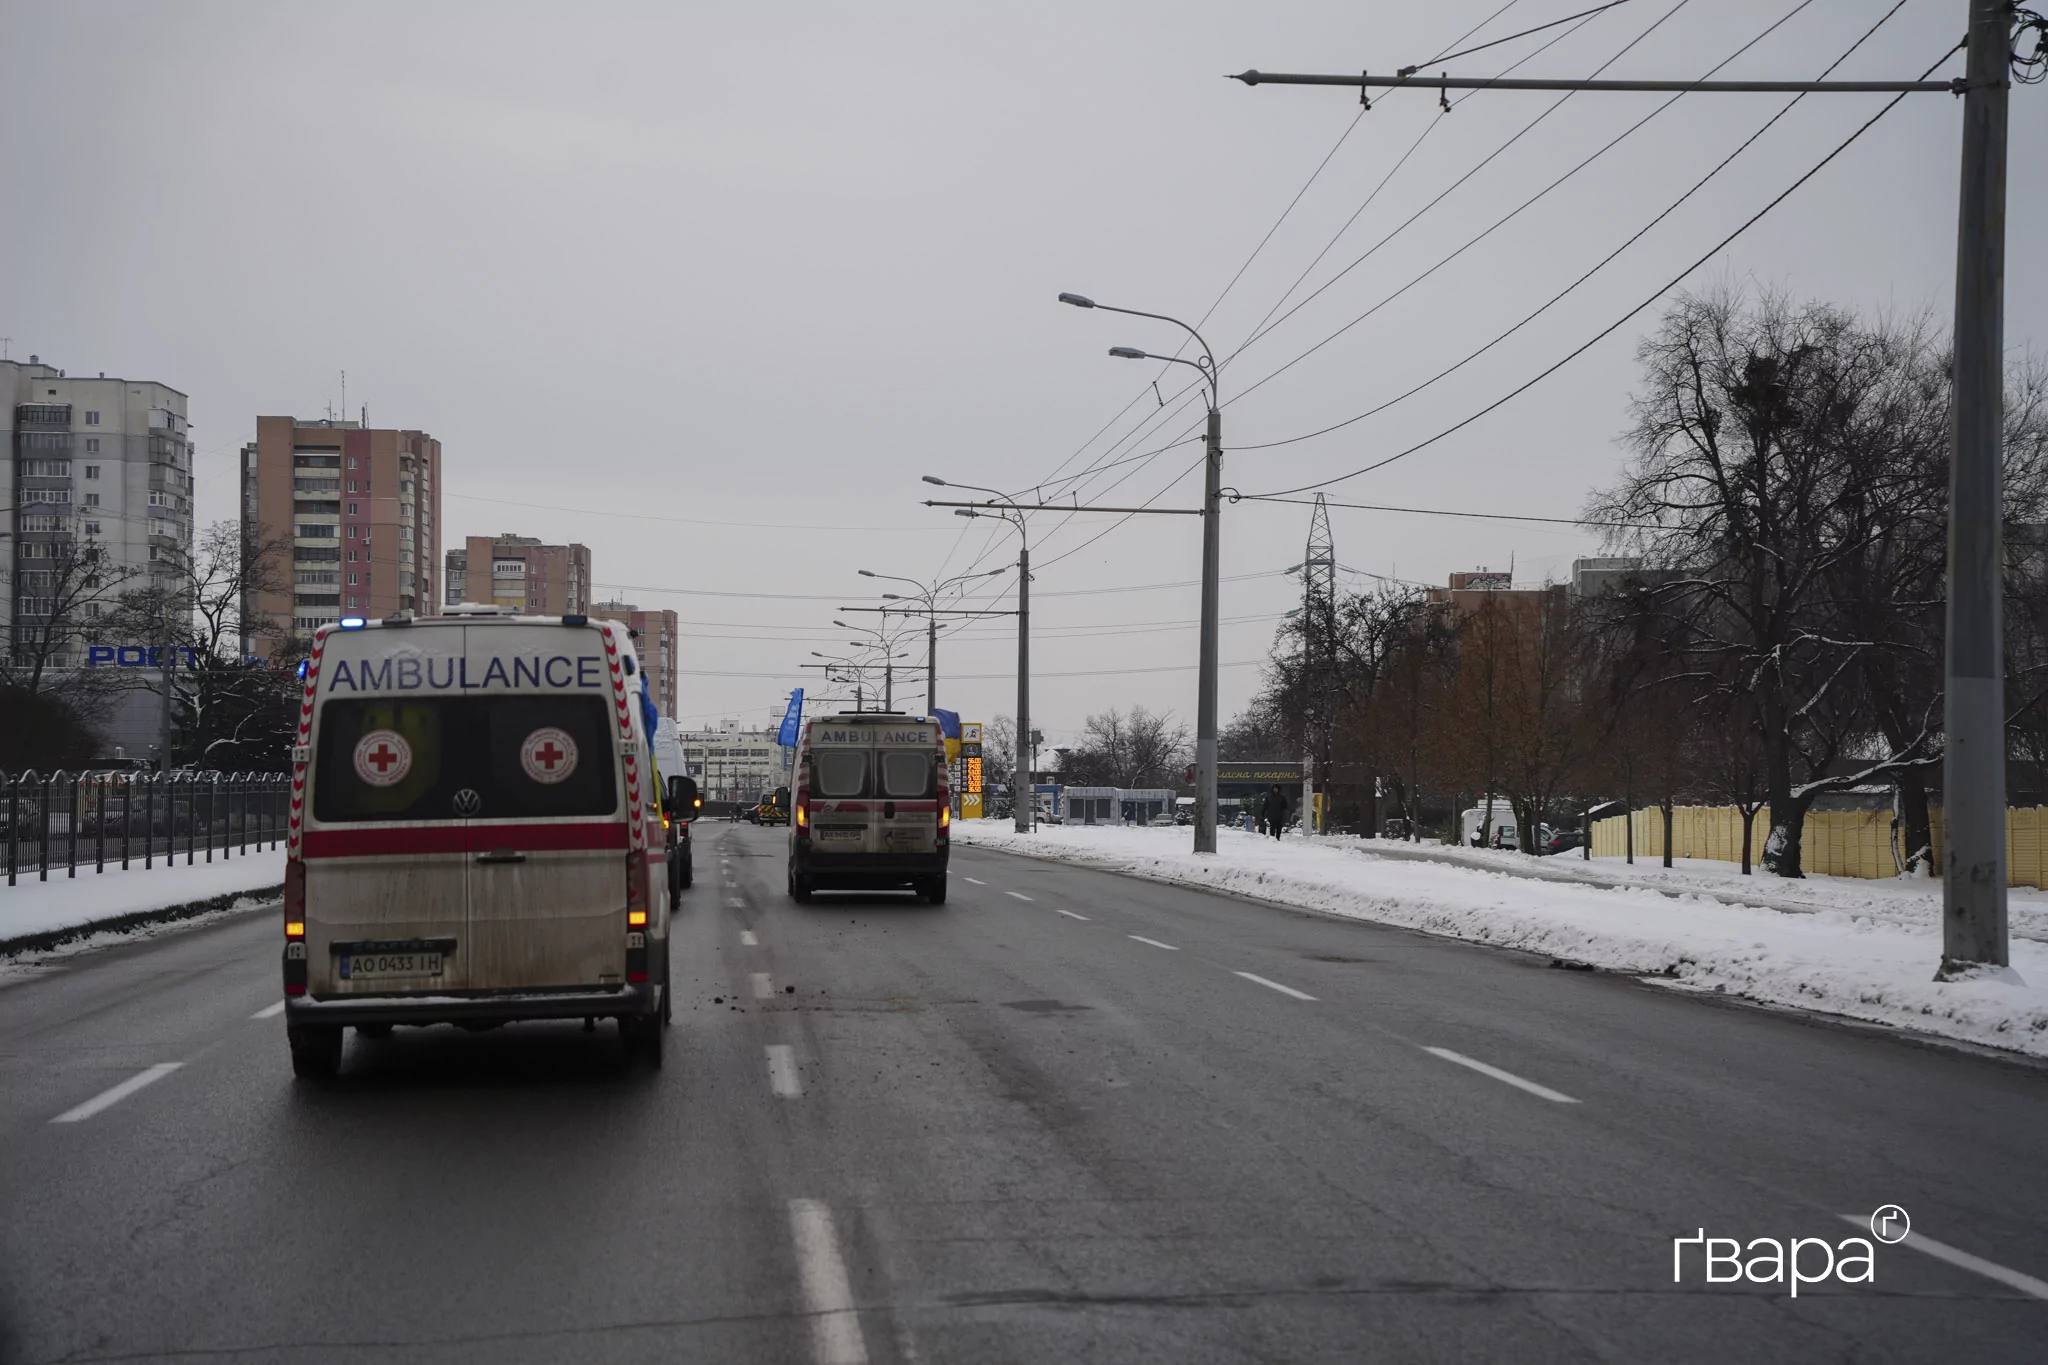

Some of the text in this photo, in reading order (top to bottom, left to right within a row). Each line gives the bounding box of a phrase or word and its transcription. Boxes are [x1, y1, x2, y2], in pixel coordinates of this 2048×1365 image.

[329, 656, 601, 692] AMBULANCE
[821, 731, 928, 743] AMBULANCE
[352, 955, 439, 973] AO 0433 IH
